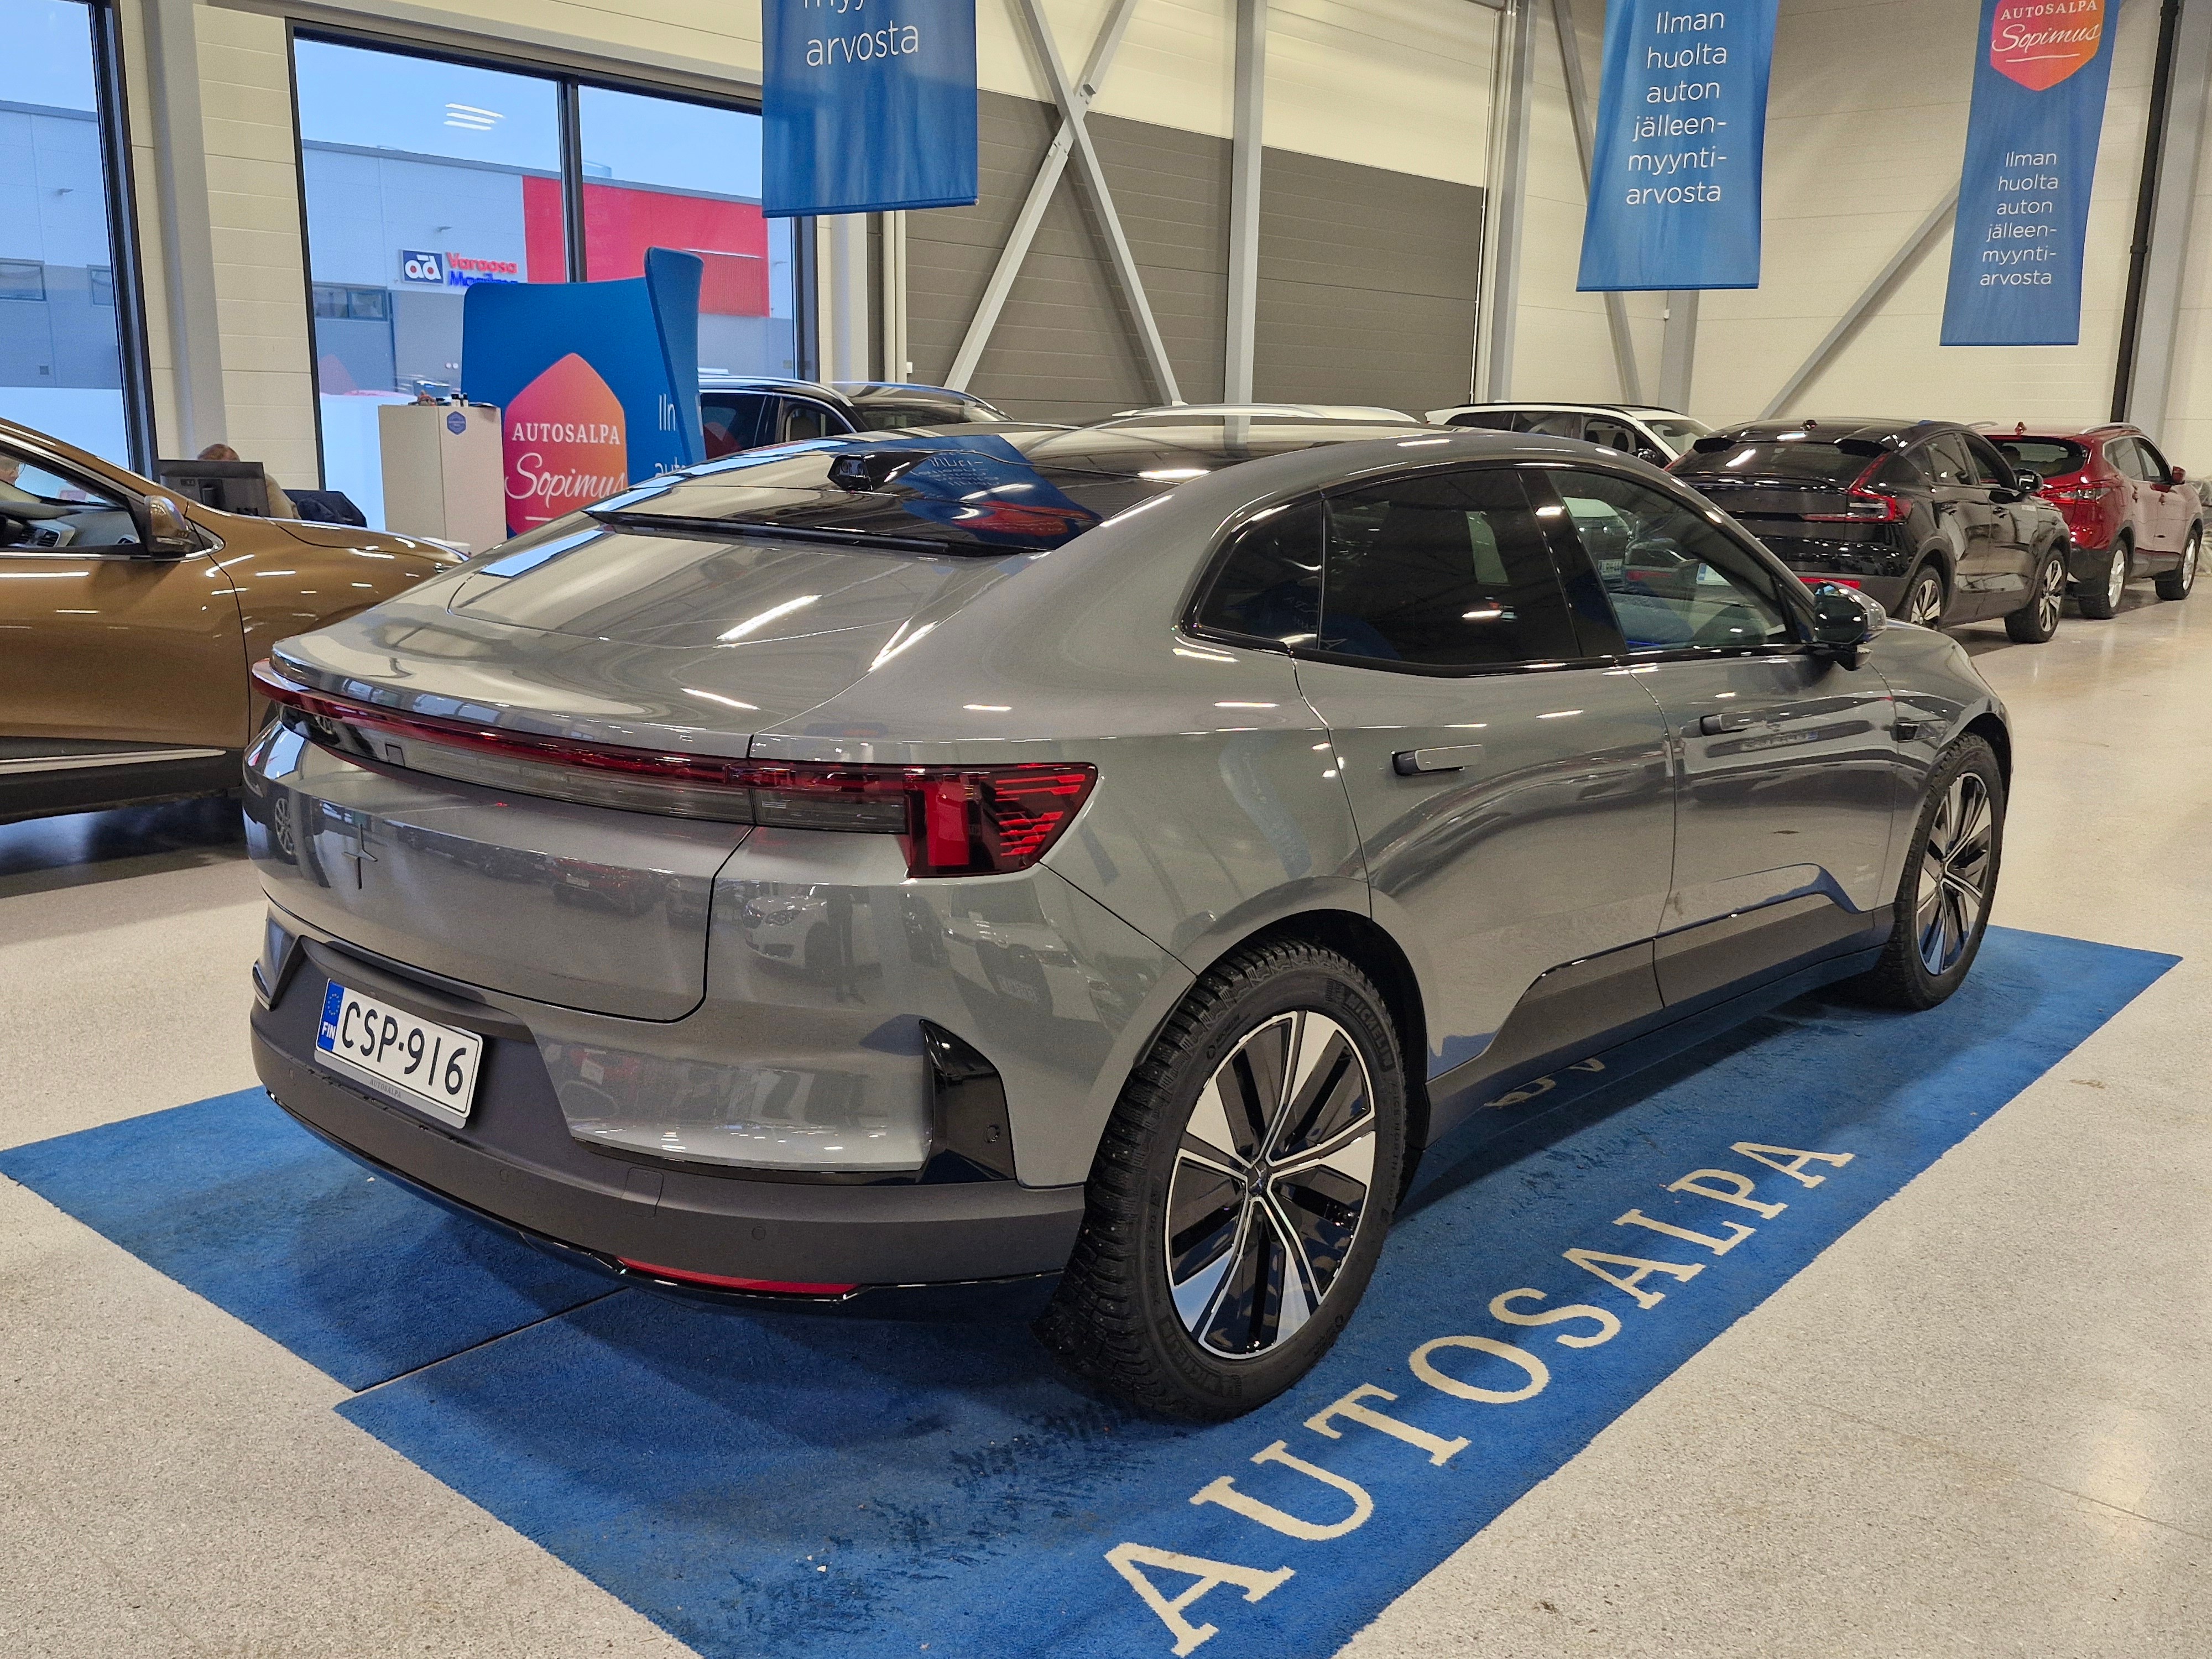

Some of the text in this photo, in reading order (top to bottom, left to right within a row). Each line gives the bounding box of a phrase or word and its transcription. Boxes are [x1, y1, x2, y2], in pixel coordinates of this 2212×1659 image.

[2000, 0, 2098, 20] AUTOSALPA
[1656, 11, 1725, 34] Ilman
[806, 20, 919, 66] arvosta
[1991, 24, 2101, 53] Sopimus
[1647, 43, 1727, 69] huolta
[1646, 80, 1720, 103] auton
[1632, 114, 1728, 142] jälleen-
[1628, 145, 1728, 175] myynti-
[2005, 151, 2057, 167] Ilman
[1626, 181, 1721, 205] arvosta
[1997, 173, 2059, 191] huolta
[1996, 199, 2053, 215] auton
[1986, 222, 2057, 242] jälleen-
[1983, 246, 2057, 265] myynti-
[1980, 270, 2052, 285] arvosta
[512, 422, 621, 445] AUTOSALPA
[504, 452, 627, 508] Sopimus
[322, 1021, 337, 1040] FIN
[342, 1001, 467, 1095] CSP-916
[370, 1078, 402, 1099] AUTOSALPA
[1104, 1140, 1855, 1658] AUTOSALPA
